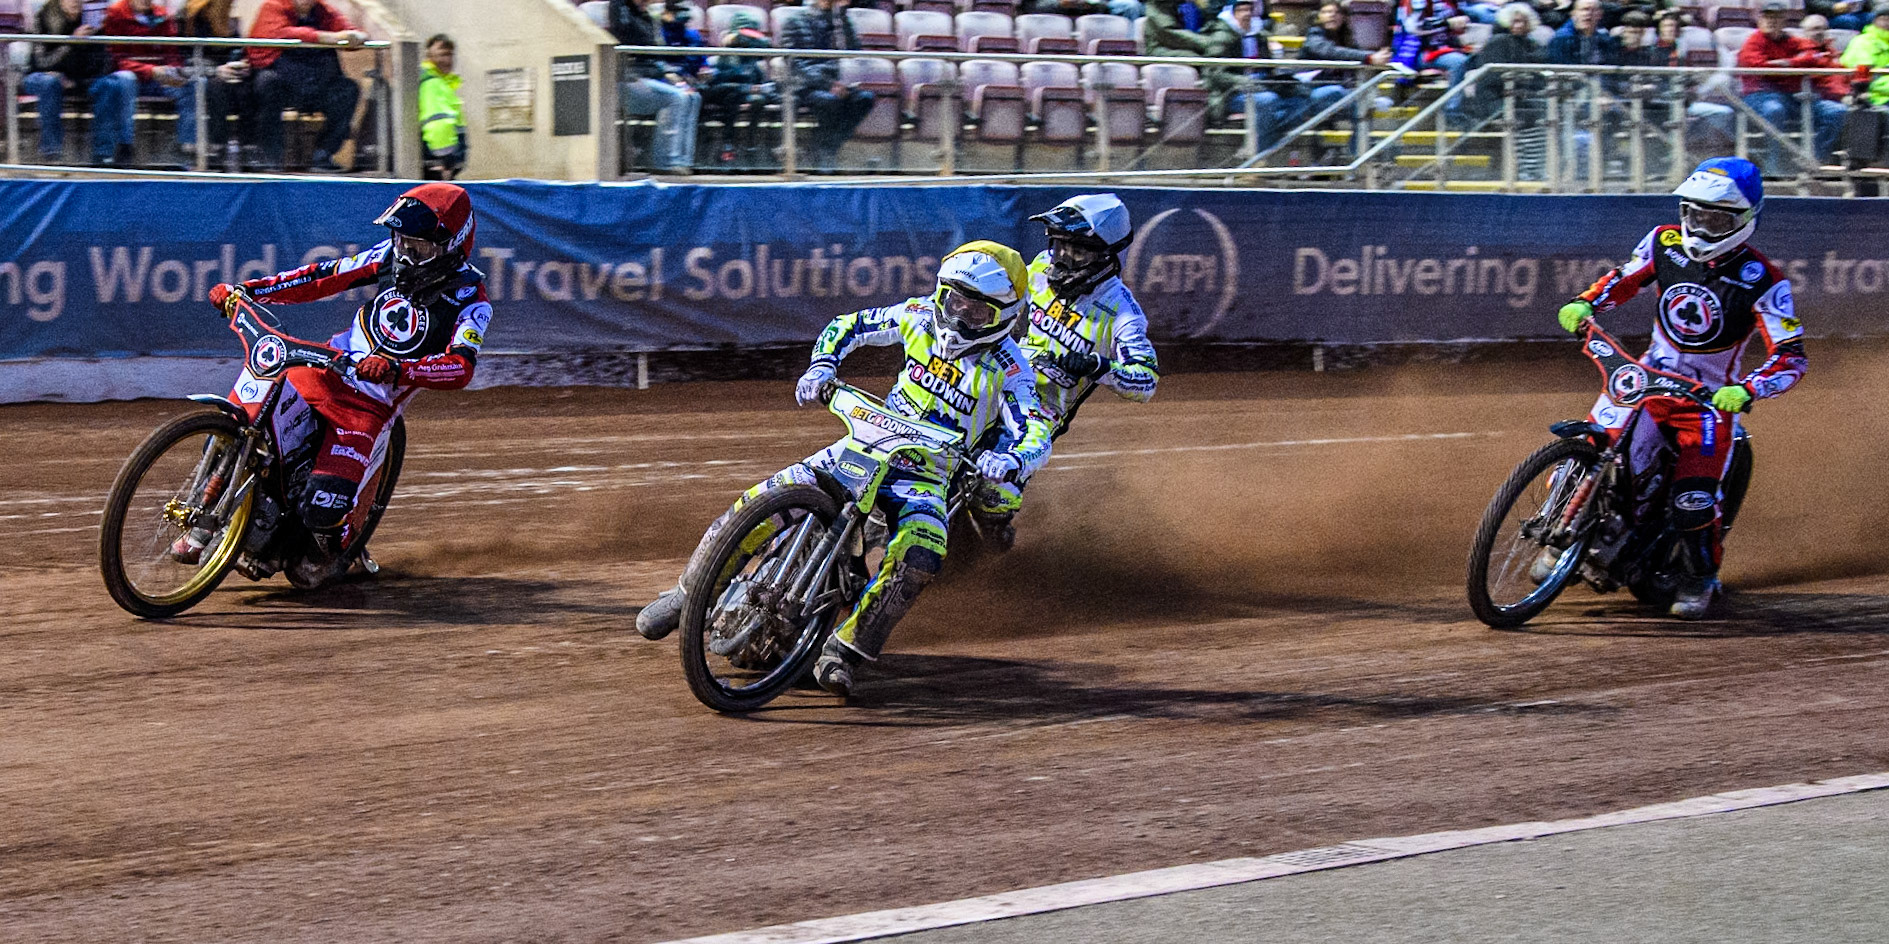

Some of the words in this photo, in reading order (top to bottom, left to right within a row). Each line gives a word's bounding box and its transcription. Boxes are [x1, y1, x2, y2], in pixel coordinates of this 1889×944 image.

[88, 244, 278, 303] World
[479, 246, 664, 301] Travel
[683, 244, 937, 299] Solutions
[1142, 254, 1217, 293] ATPI
[1294, 245, 1539, 307] Delivering
[1029, 304, 1091, 356] GOODWIN
[906, 358, 975, 415] GOODWIN
[928, 356, 964, 386] BET
